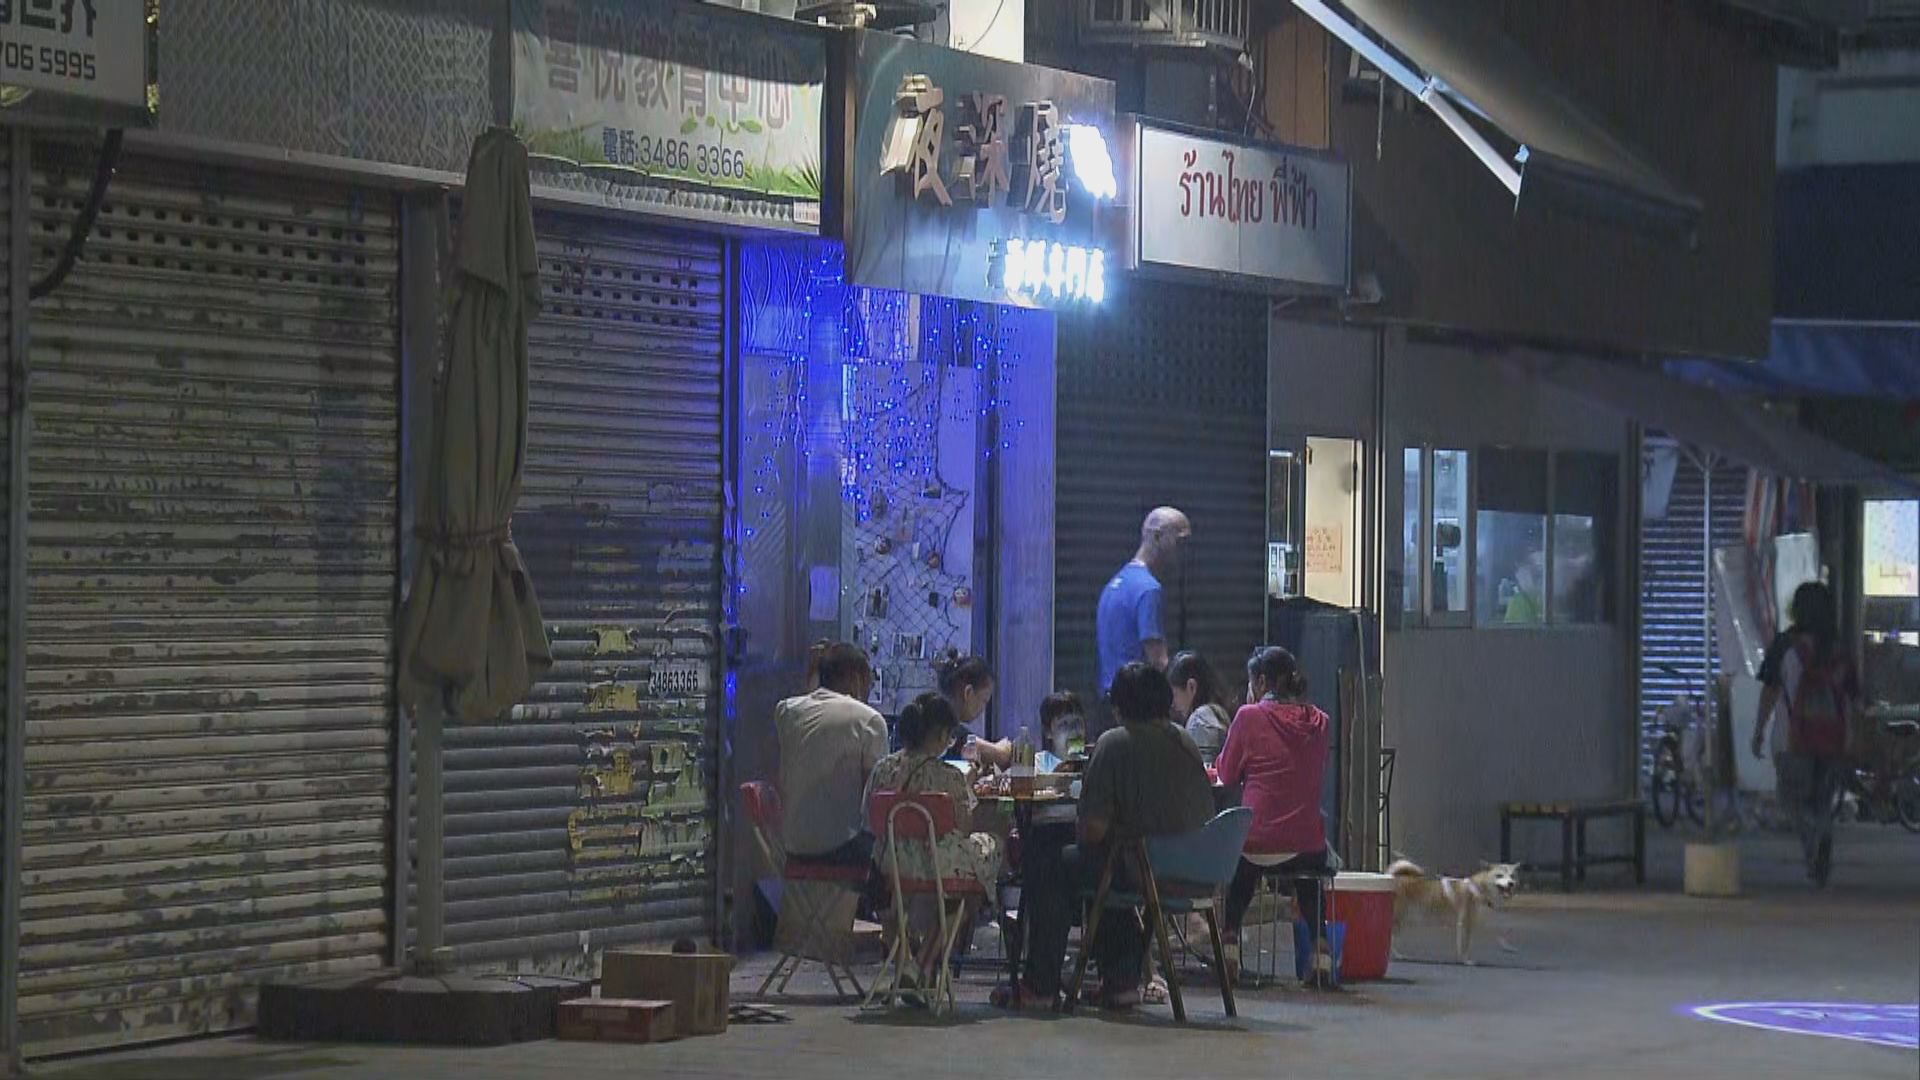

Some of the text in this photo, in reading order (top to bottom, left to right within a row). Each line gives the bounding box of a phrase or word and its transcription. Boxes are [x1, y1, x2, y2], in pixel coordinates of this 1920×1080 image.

[0, 42, 96, 80] 06 5995
[545, 4, 794, 129] 喜悅教育中心
[697, 144, 744, 179] 3366
[650, 669, 699, 692] 34863366
